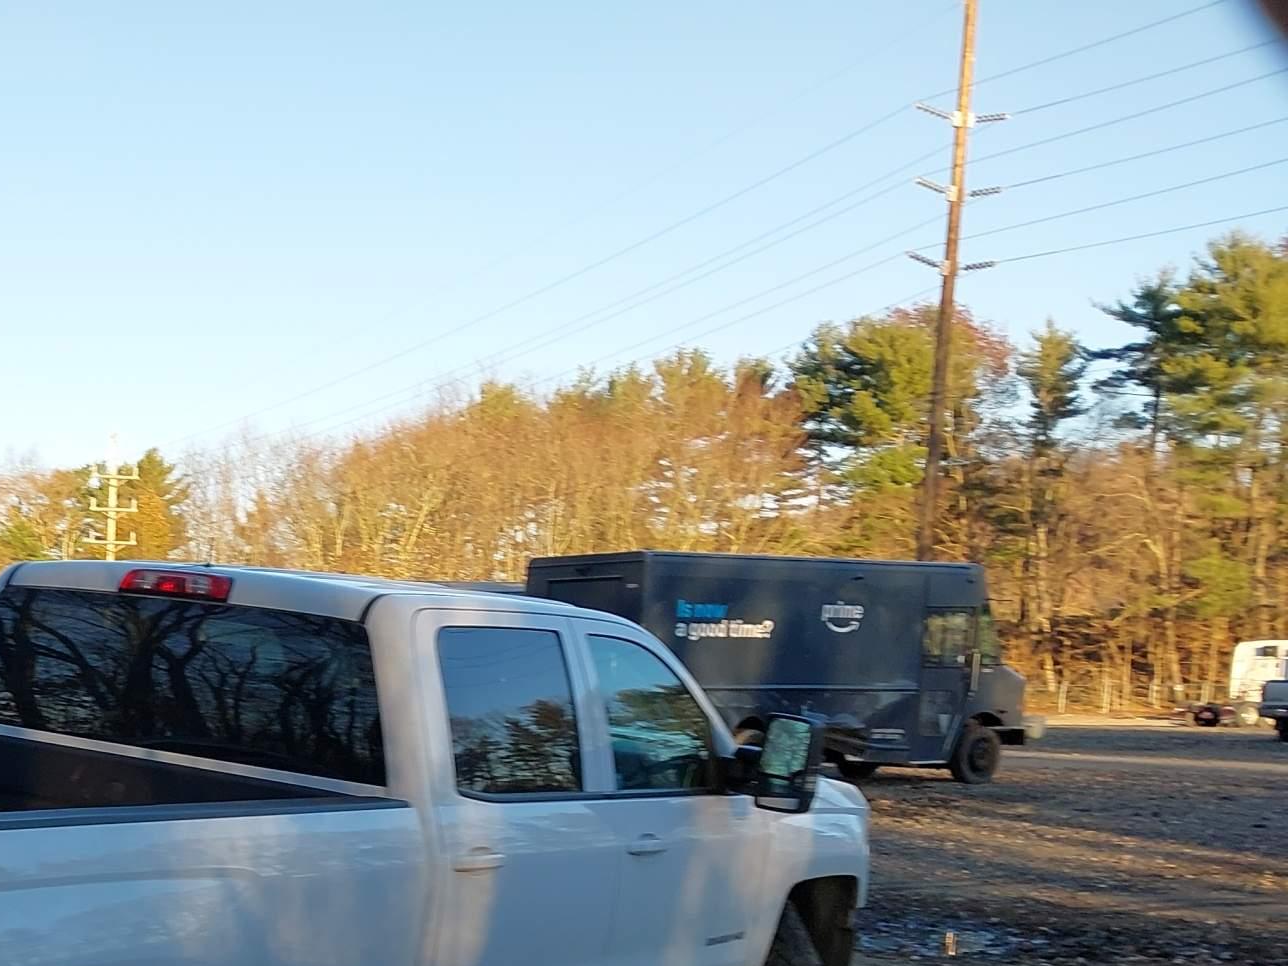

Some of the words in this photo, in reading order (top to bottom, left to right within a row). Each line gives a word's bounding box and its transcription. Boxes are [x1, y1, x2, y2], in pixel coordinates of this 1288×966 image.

[821, 600, 865, 622] prime
[675, 622, 687, 637] a
[688, 619, 728, 640] good
[729, 619, 775, 639] time?
